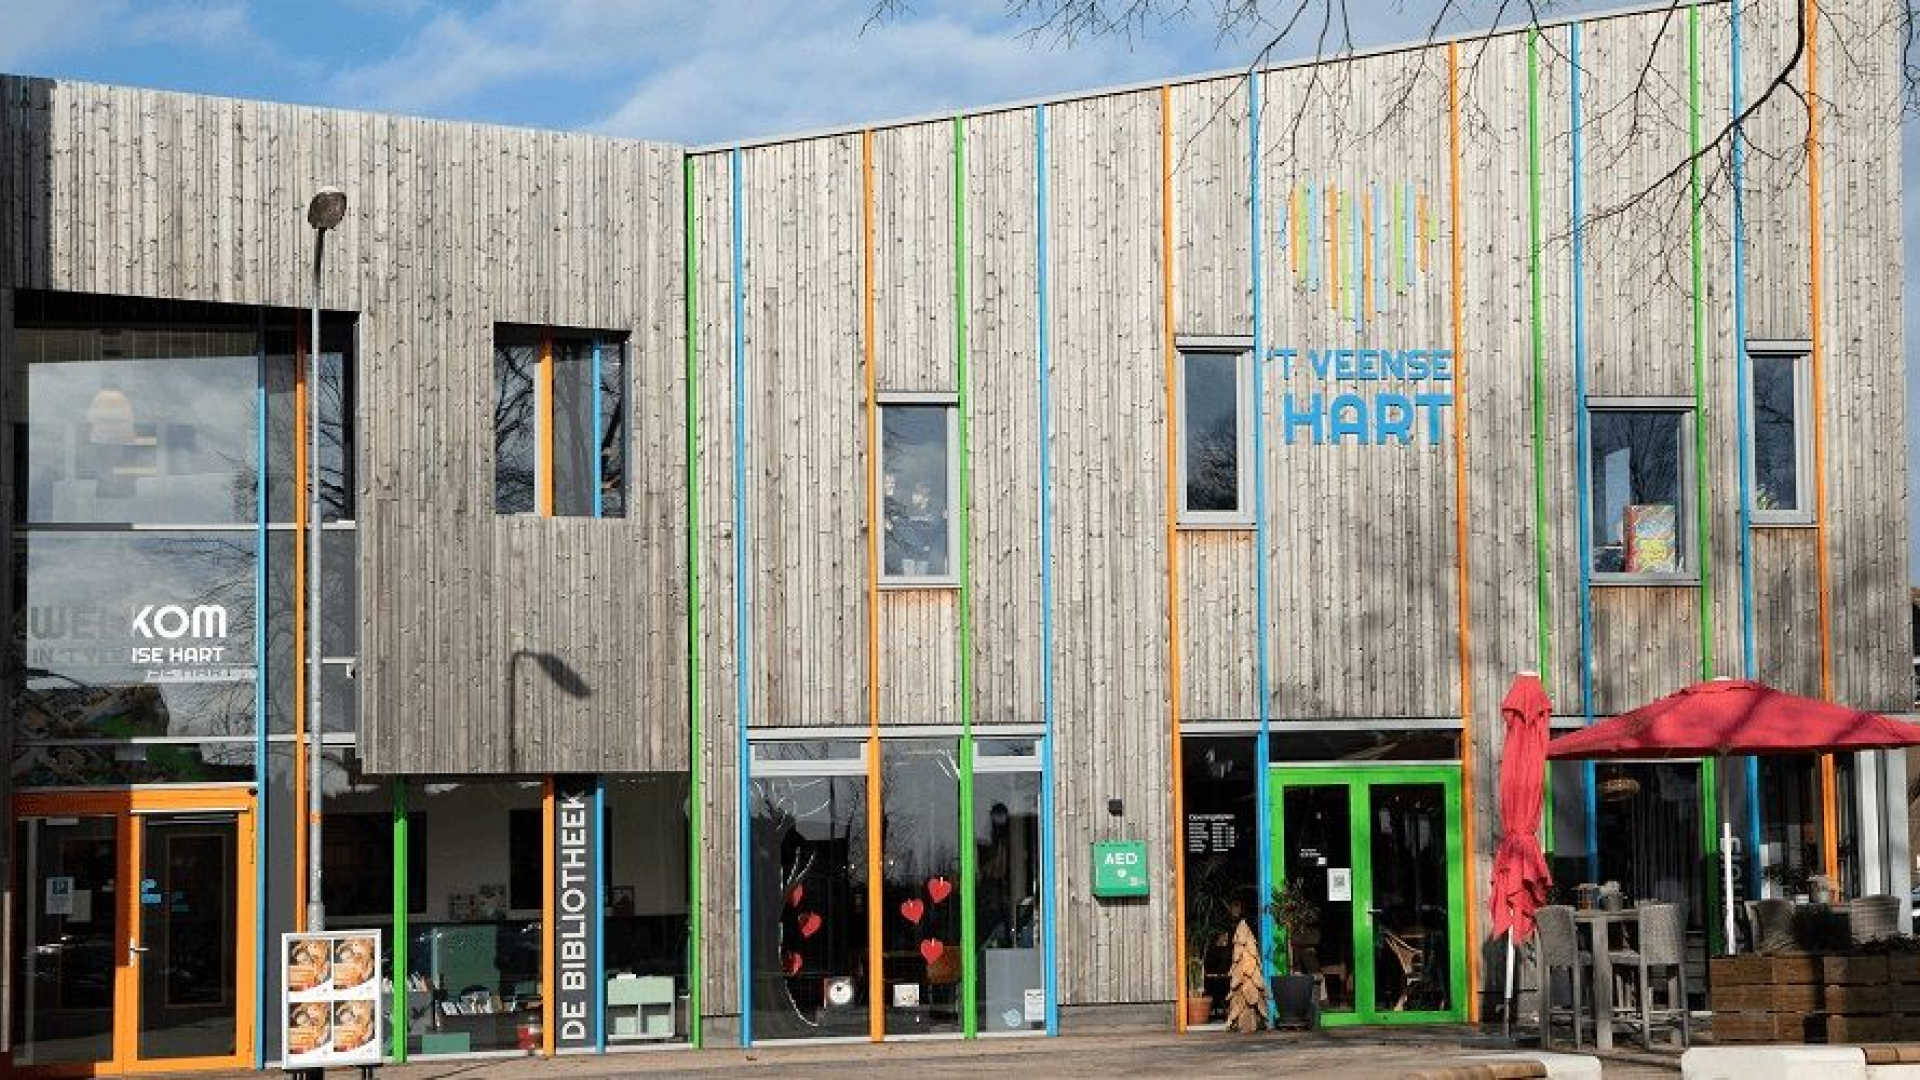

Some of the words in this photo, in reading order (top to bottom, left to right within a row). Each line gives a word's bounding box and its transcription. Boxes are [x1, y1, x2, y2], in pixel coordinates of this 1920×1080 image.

[1267, 348, 1298, 381] 'T
[1308, 348, 1452, 381] VEENSE
[1284, 394, 1453, 446] HART
[168, 647, 226, 662] HART
[1104, 853, 1138, 865] AED
[561, 791, 587, 991] BIBLIOTHEEK
[562, 1001, 586, 1041] DE
